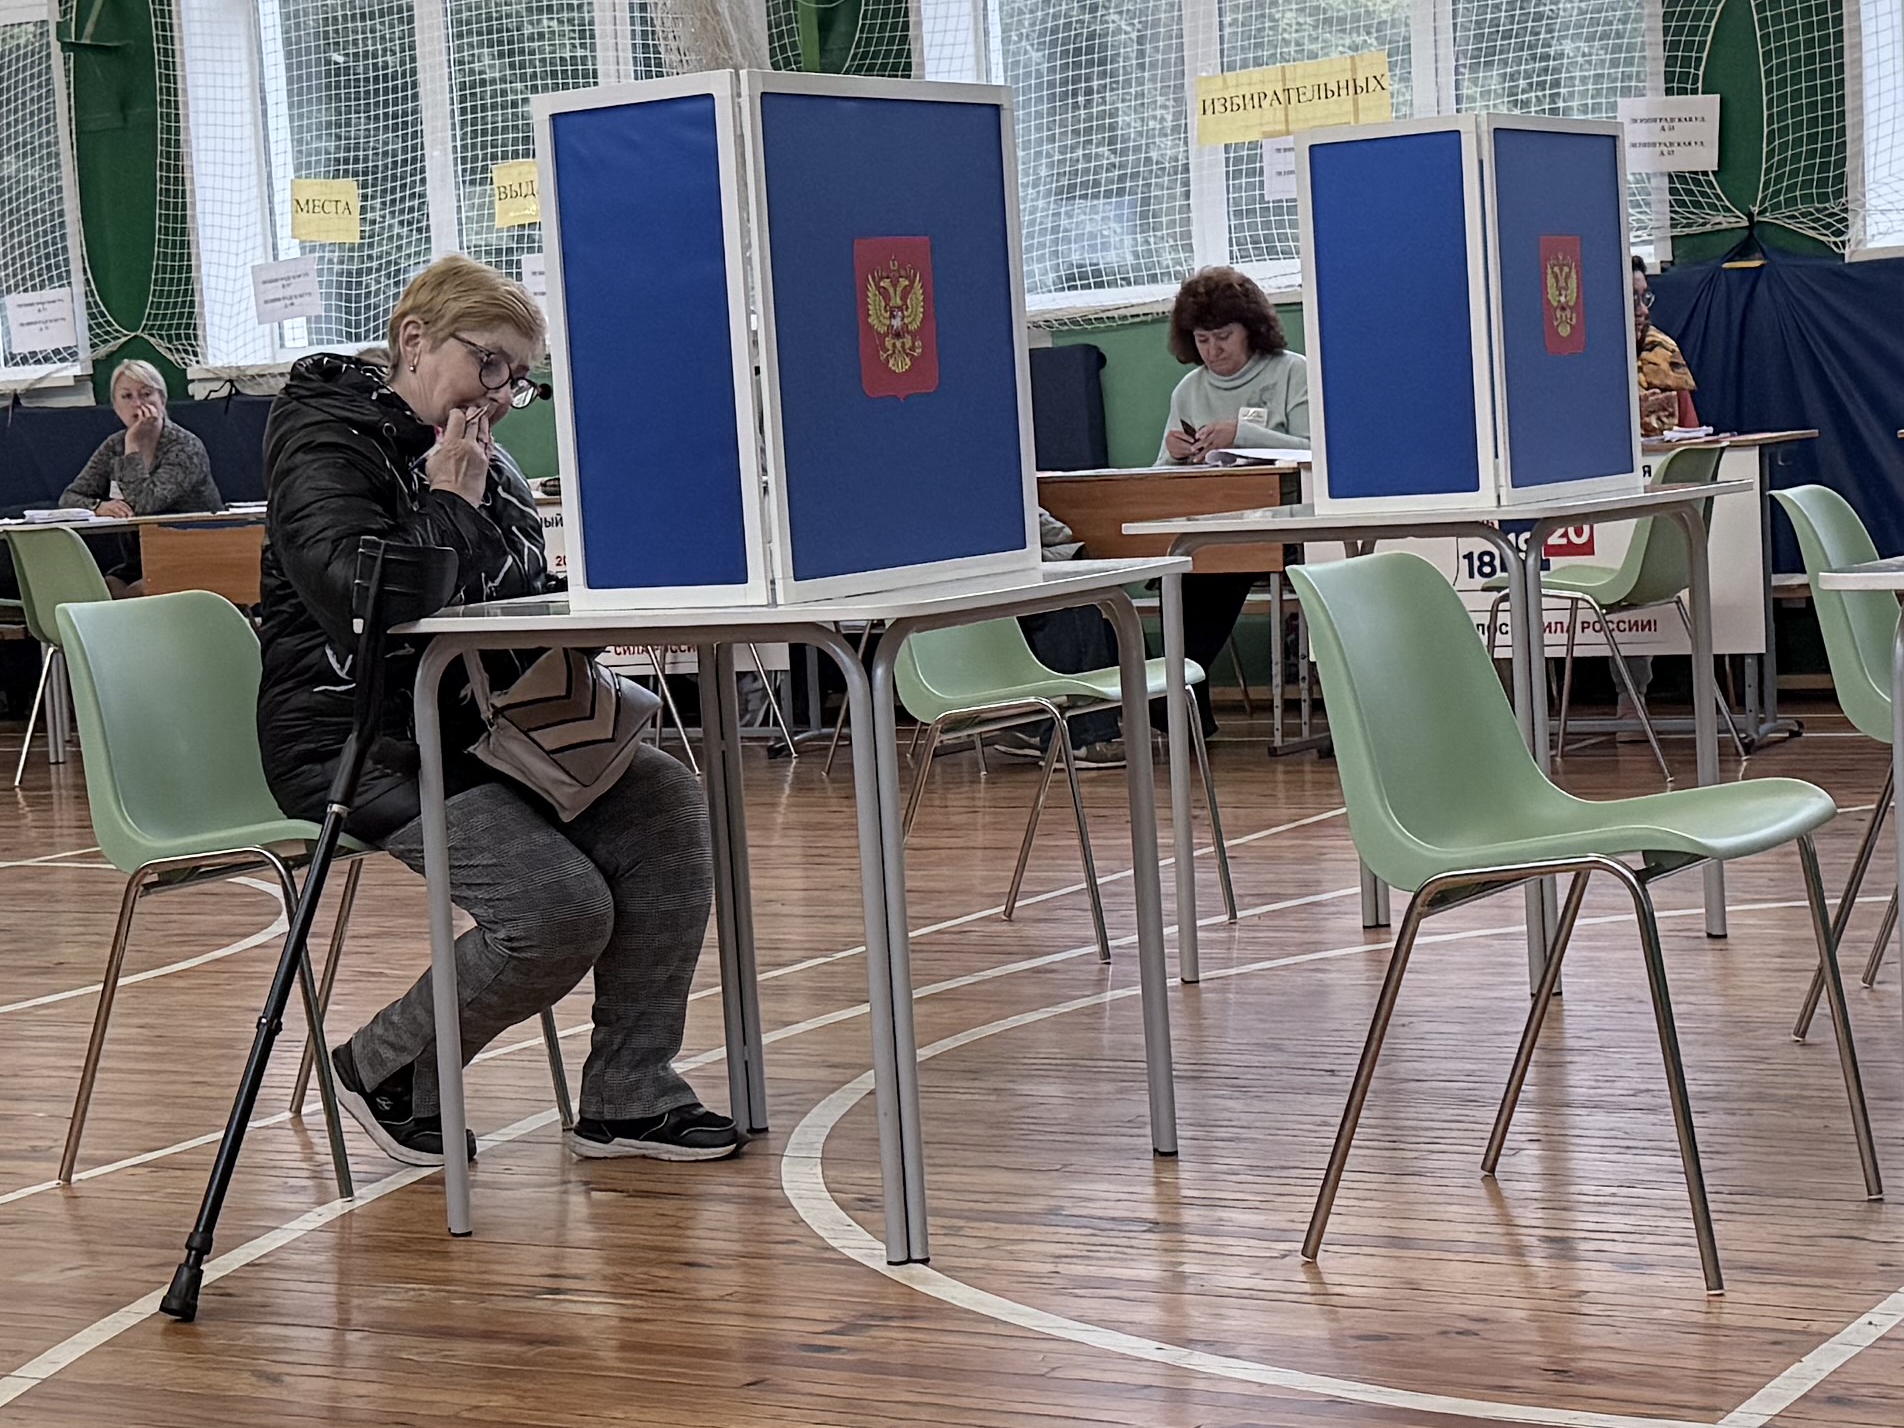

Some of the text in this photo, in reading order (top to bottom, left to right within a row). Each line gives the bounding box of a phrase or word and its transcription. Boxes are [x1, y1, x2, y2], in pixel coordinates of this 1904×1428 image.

[1201, 74, 1387, 116] ИЗБИРАТЕЛЬНЫХ
[497, 179, 537, 201] ВЫД
[293, 198, 353, 216] МЕСТА
[1462, 550, 1497, 580] 18
[1581, 619, 1658, 634] РОССИИ!
